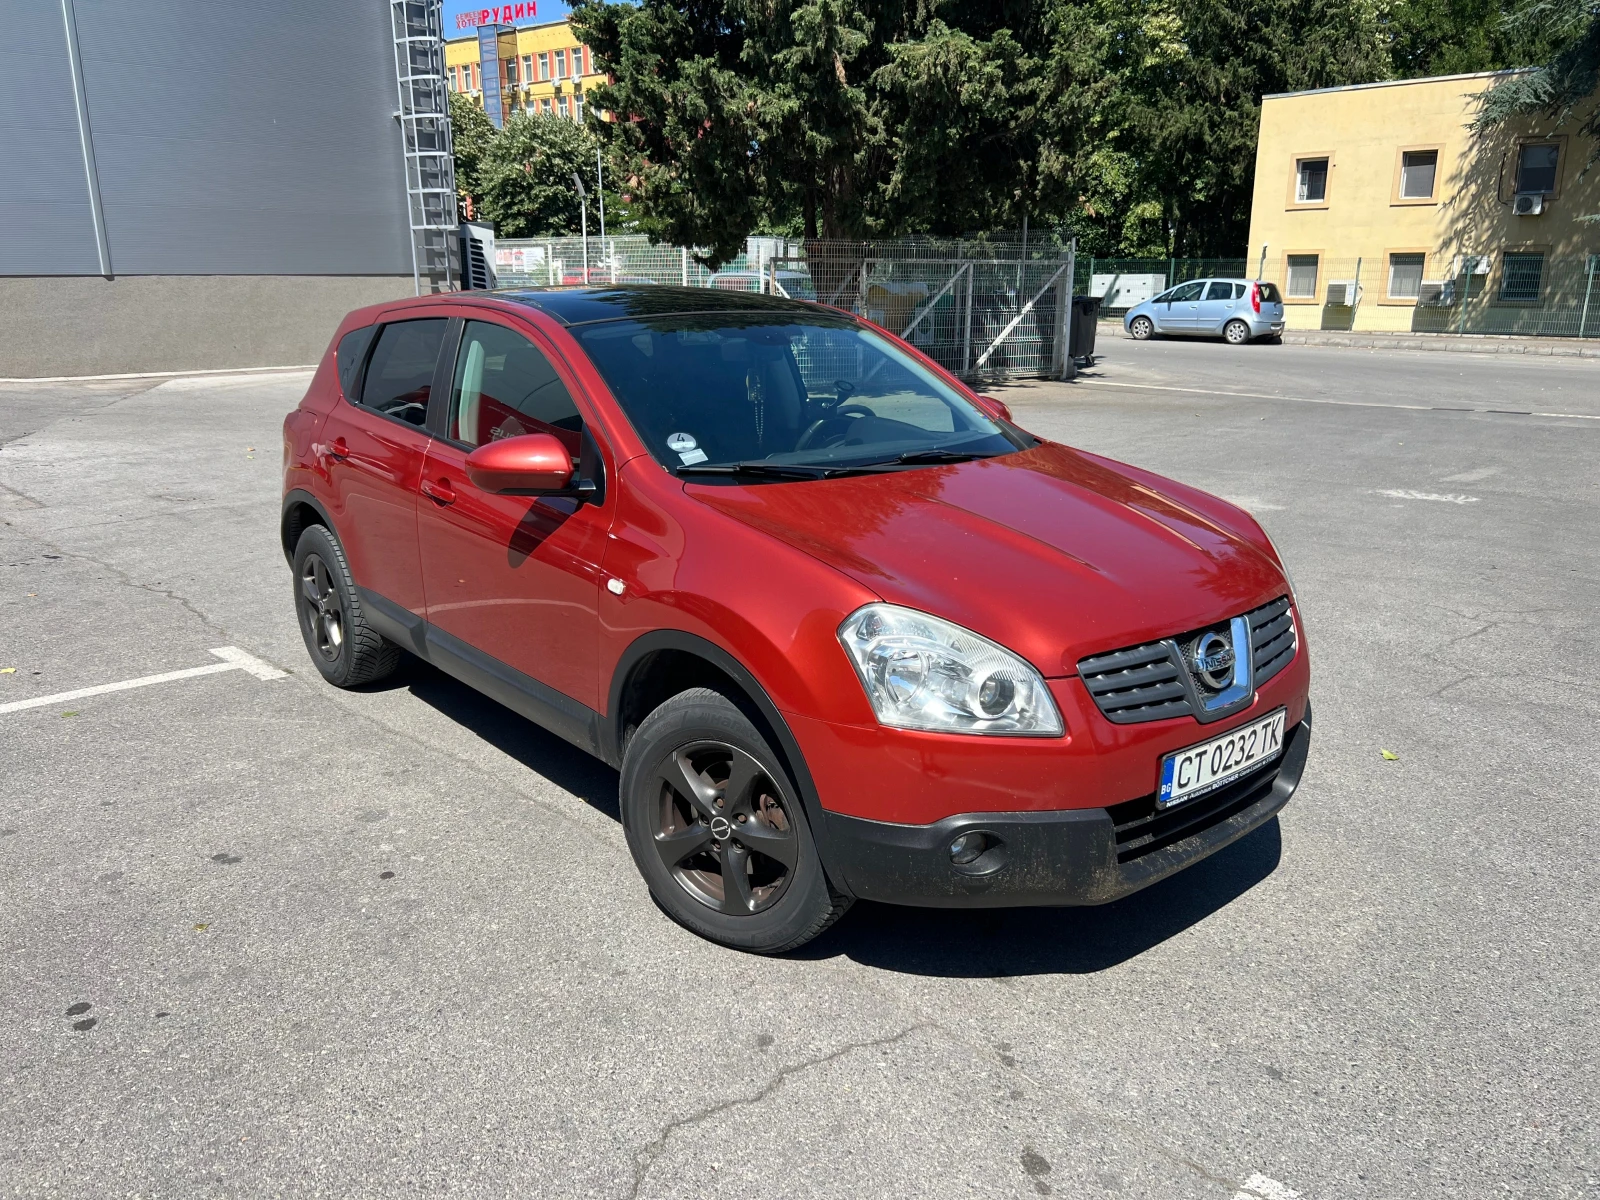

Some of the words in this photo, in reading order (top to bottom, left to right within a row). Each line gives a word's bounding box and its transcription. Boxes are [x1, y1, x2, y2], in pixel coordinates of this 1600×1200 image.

[482, 1, 537, 24] РУДИН
[1178, 750, 1207, 789] CT
[1211, 729, 1257, 776] 0232
[1261, 715, 1281, 753] TK
[1161, 783, 1172, 795] BG
